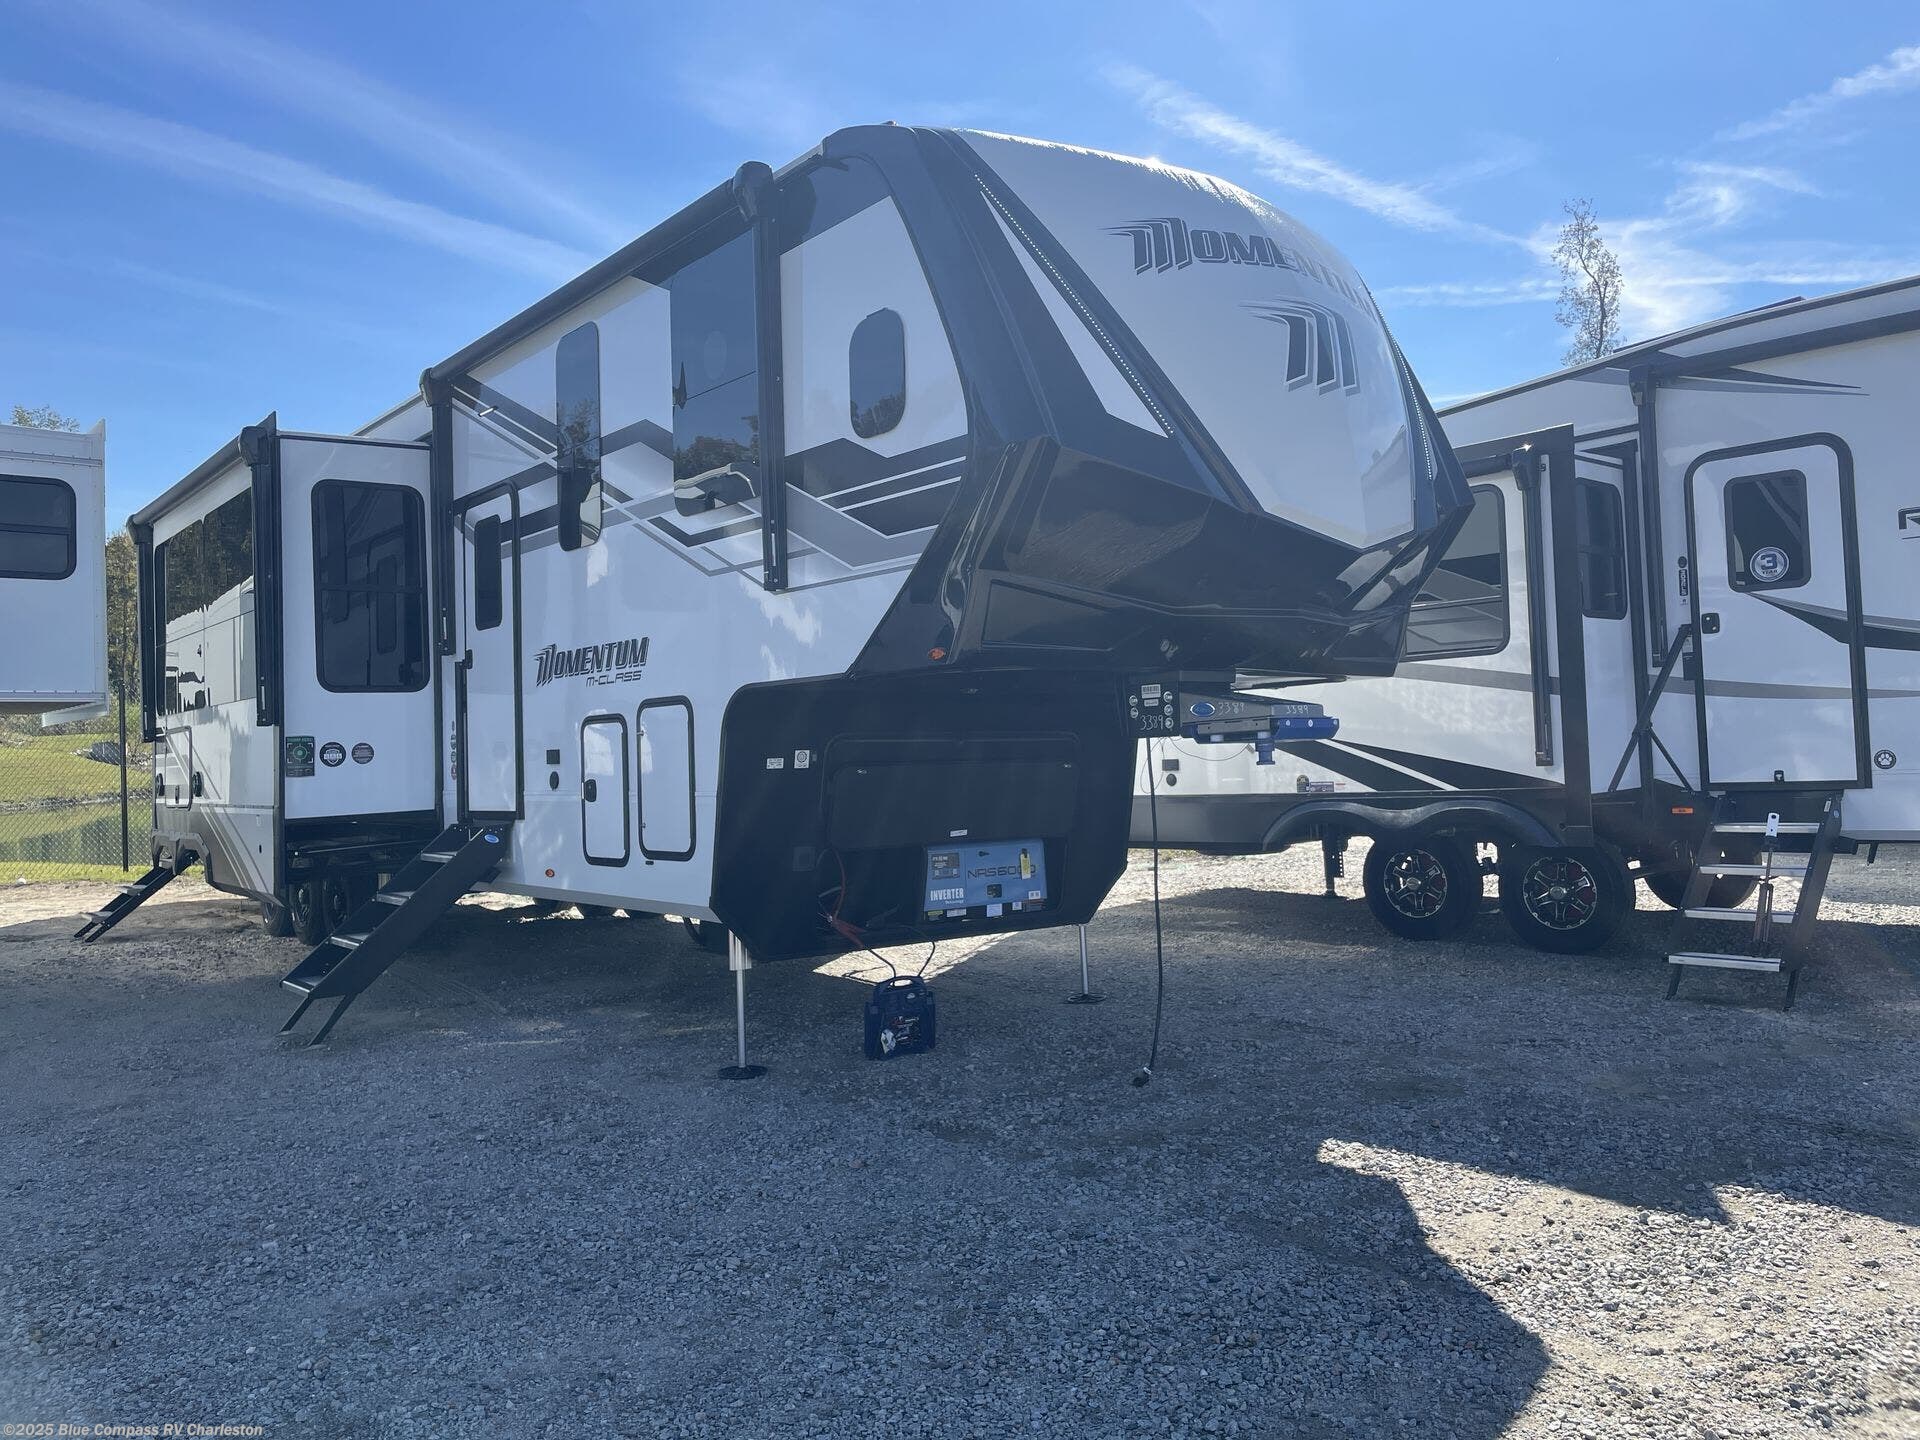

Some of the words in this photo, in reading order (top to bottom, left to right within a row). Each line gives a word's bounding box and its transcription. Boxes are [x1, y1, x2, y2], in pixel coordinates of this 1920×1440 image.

[1760, 553, 1778, 570] 3
[533, 637, 650, 687] MOMENTUM
[586, 670, 642, 687] M-CLASS
[1218, 702, 1245, 716] 3389
[1140, 714, 1164, 731] 3389
[930, 888, 964, 901] INVERTER
